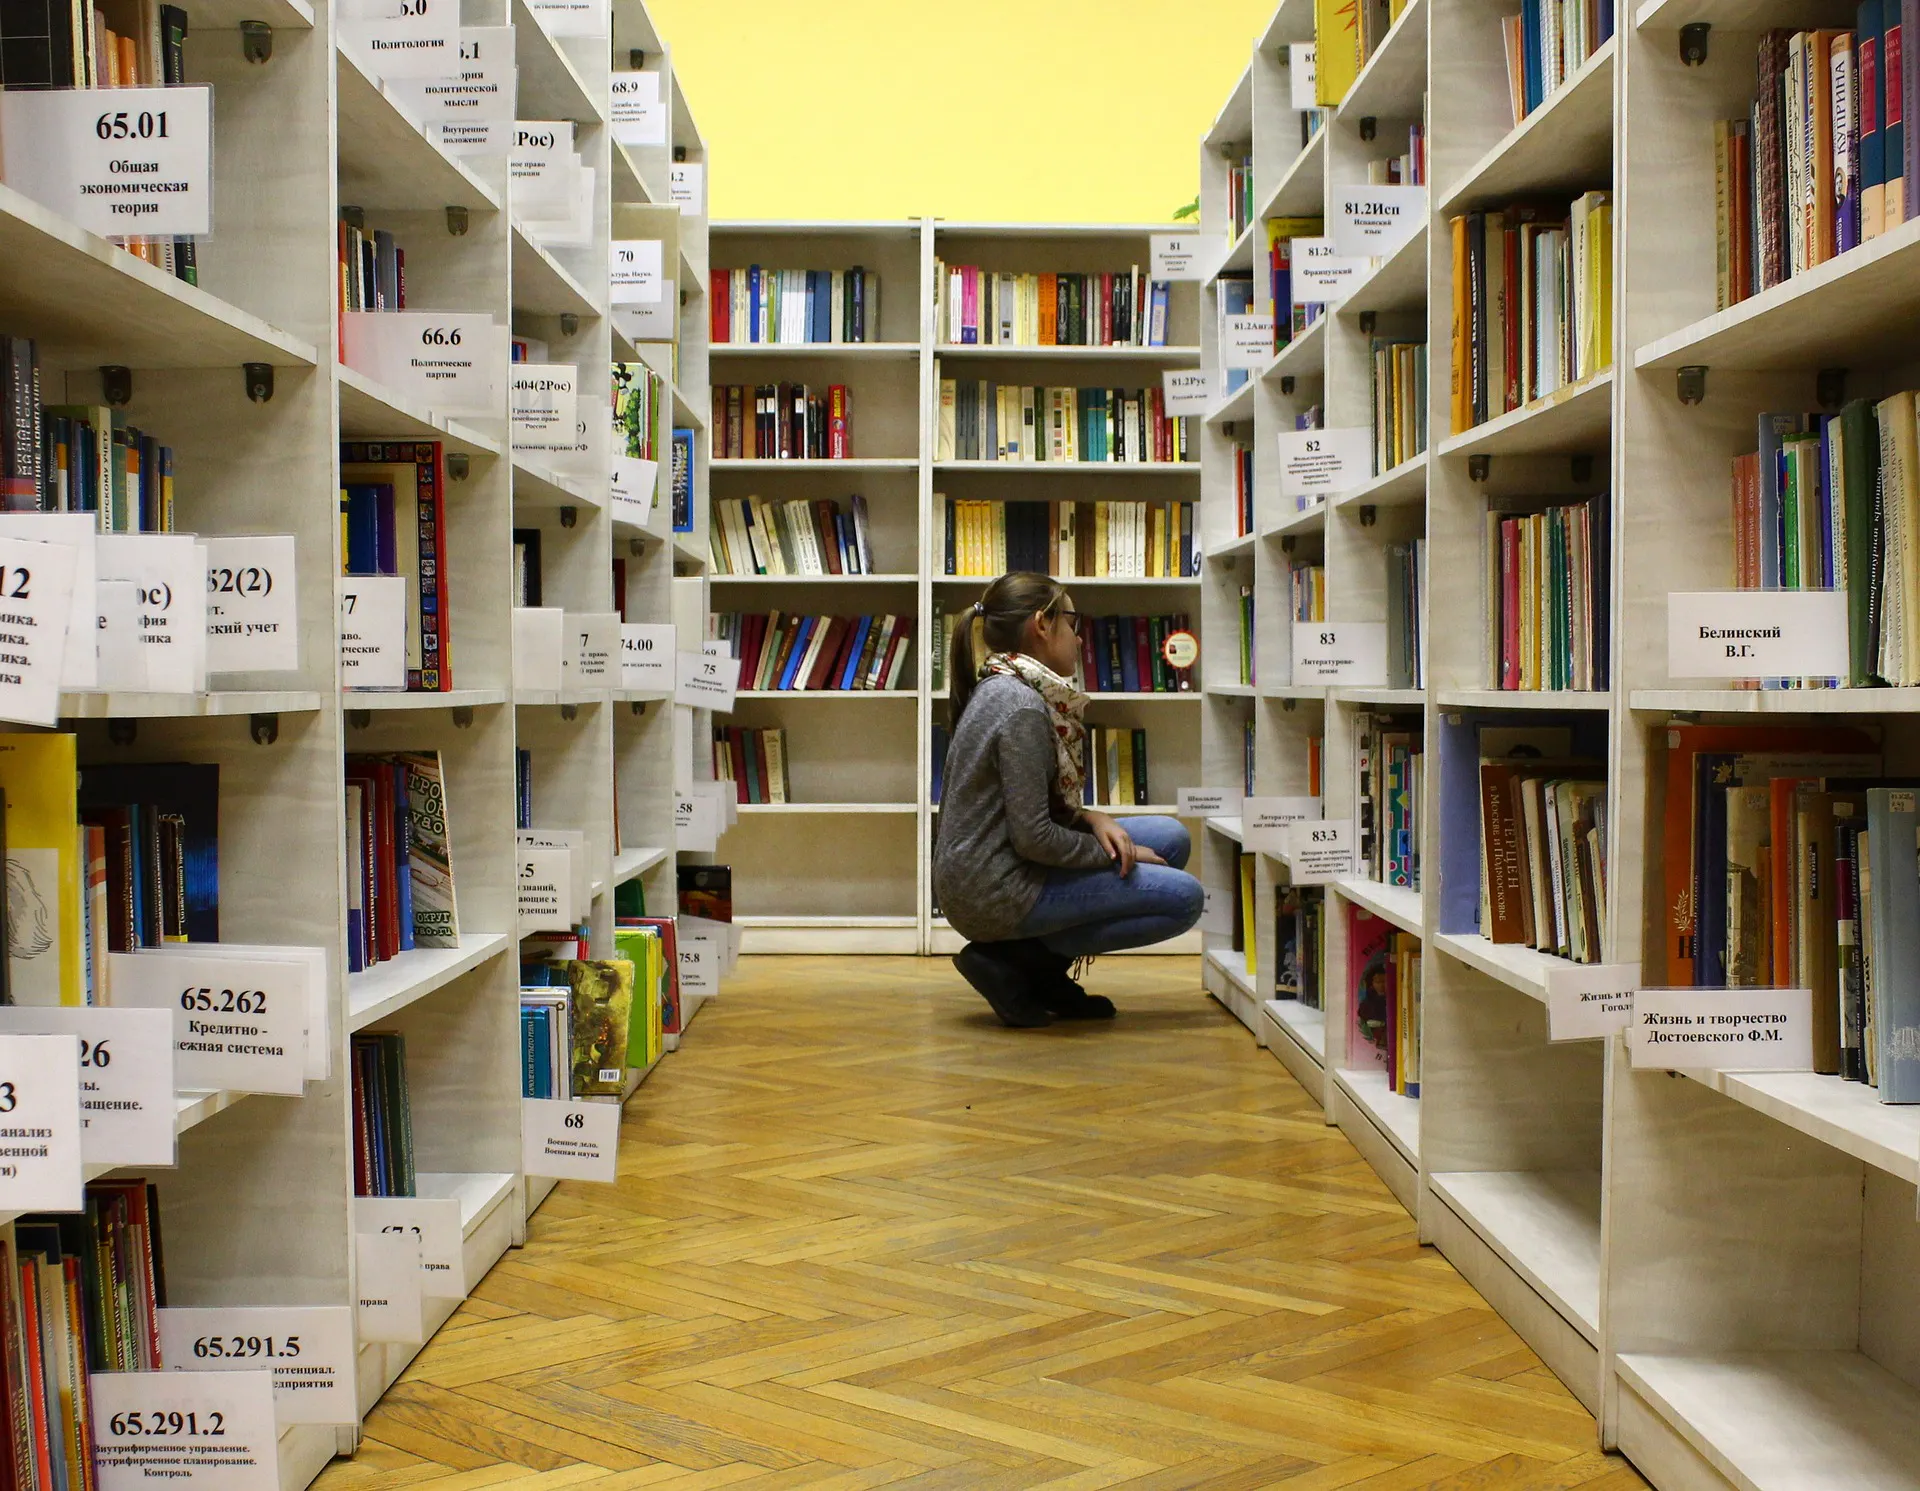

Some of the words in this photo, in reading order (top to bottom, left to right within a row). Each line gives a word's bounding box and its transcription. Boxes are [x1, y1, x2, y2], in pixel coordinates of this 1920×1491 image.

[372, 40, 444, 49] Политология
[426, 84, 497, 93] политической
[612, 82, 638, 93] 68.9
[1837, 60, 1847, 156] КУПРИНА
[96, 112, 168, 139] 65.01
[443, 126, 488, 134] Внутреннее
[110, 160, 158, 173] Общая
[80, 183, 188, 194] экономическая
[111, 203, 158, 216] теория
[1345, 203, 1399, 215] 81.2Исп
[619, 251, 633, 262] 70
[1303, 269, 1352, 277] Французский
[422, 328, 461, 345] 66.6
[412, 359, 471, 367] Политические
[1172, 377, 1205, 386] 81.2Рус
[1307, 441, 1320, 451] 82
[247, 624, 278, 636] учет
[1700, 627, 1780, 638] Белинский
[1320, 633, 1335, 644] 83
[1726, 645, 1754, 657] В.Г.
[704, 664, 716, 674] 75
[1313, 830, 1337, 841] 83.3
[1504, 818, 1519, 889] ГЕРЦЕН
[523, 884, 556, 892] знаний,
[416, 910, 450, 923] ОКРУГ
[680, 953, 699, 962] 75.8
[181, 988, 266, 1014] 65.262
[1580, 993, 1613, 1001] Жизнь
[1644, 1013, 1692, 1024] Жизнь
[1697, 1016, 1704, 1024] и
[1710, 1015, 1786, 1027] творчество
[190, 1021, 258, 1036] Кредитно
[1648, 1031, 1744, 1044] Достоевского
[1748, 1030, 1782, 1041] Ф.М.
[228, 1044, 283, 1055] система
[565, 1114, 583, 1128] 68
[1, 1129, 52, 1137] анализ
[548, 1138, 577, 1146] Военное
[545, 1147, 575, 1156] Военная
[194, 1337, 300, 1358] 65.291.5
[110, 1412, 224, 1435] 65.291.2
[189, 1446, 250, 1454] управление.
[183, 1458, 256, 1467] планирование.
[144, 1468, 192, 1478] Контроль
